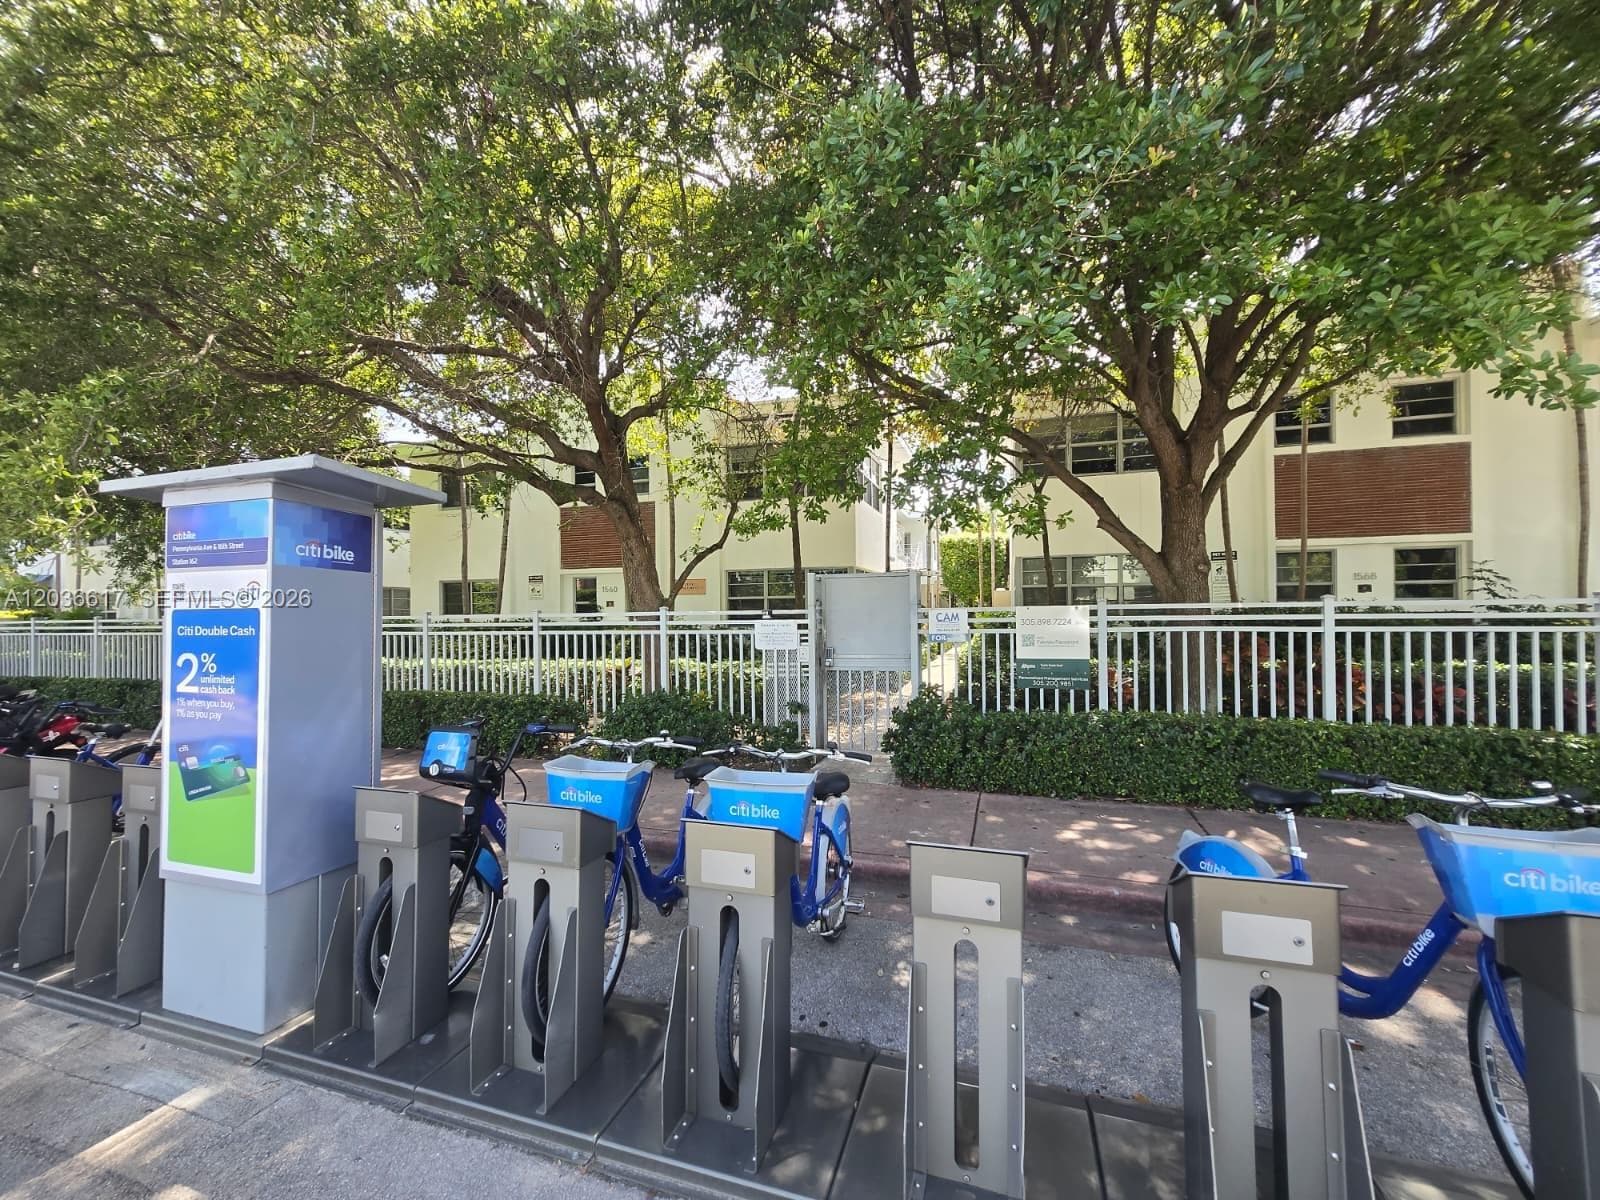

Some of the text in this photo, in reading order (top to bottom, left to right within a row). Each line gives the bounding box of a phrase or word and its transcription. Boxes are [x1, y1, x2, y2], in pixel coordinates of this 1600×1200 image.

[296, 542, 355, 562] citi bike
[936, 612, 960, 622] CAM
[177, 625, 255, 636] Citi Double Cash
[200, 674, 235, 684] unlimited
[200, 685, 235, 694] cash back
[176, 697, 186, 706] 1%
[187, 698, 205, 707] when
[205, 700, 220, 709] you
[176, 709, 222, 721] 1% as you pay
[560, 790, 602, 803] citi bike
[729, 803, 780, 819] citi bike
[1503, 870, 1600, 896] citi bike
[1402, 928, 1436, 967] citi bike
